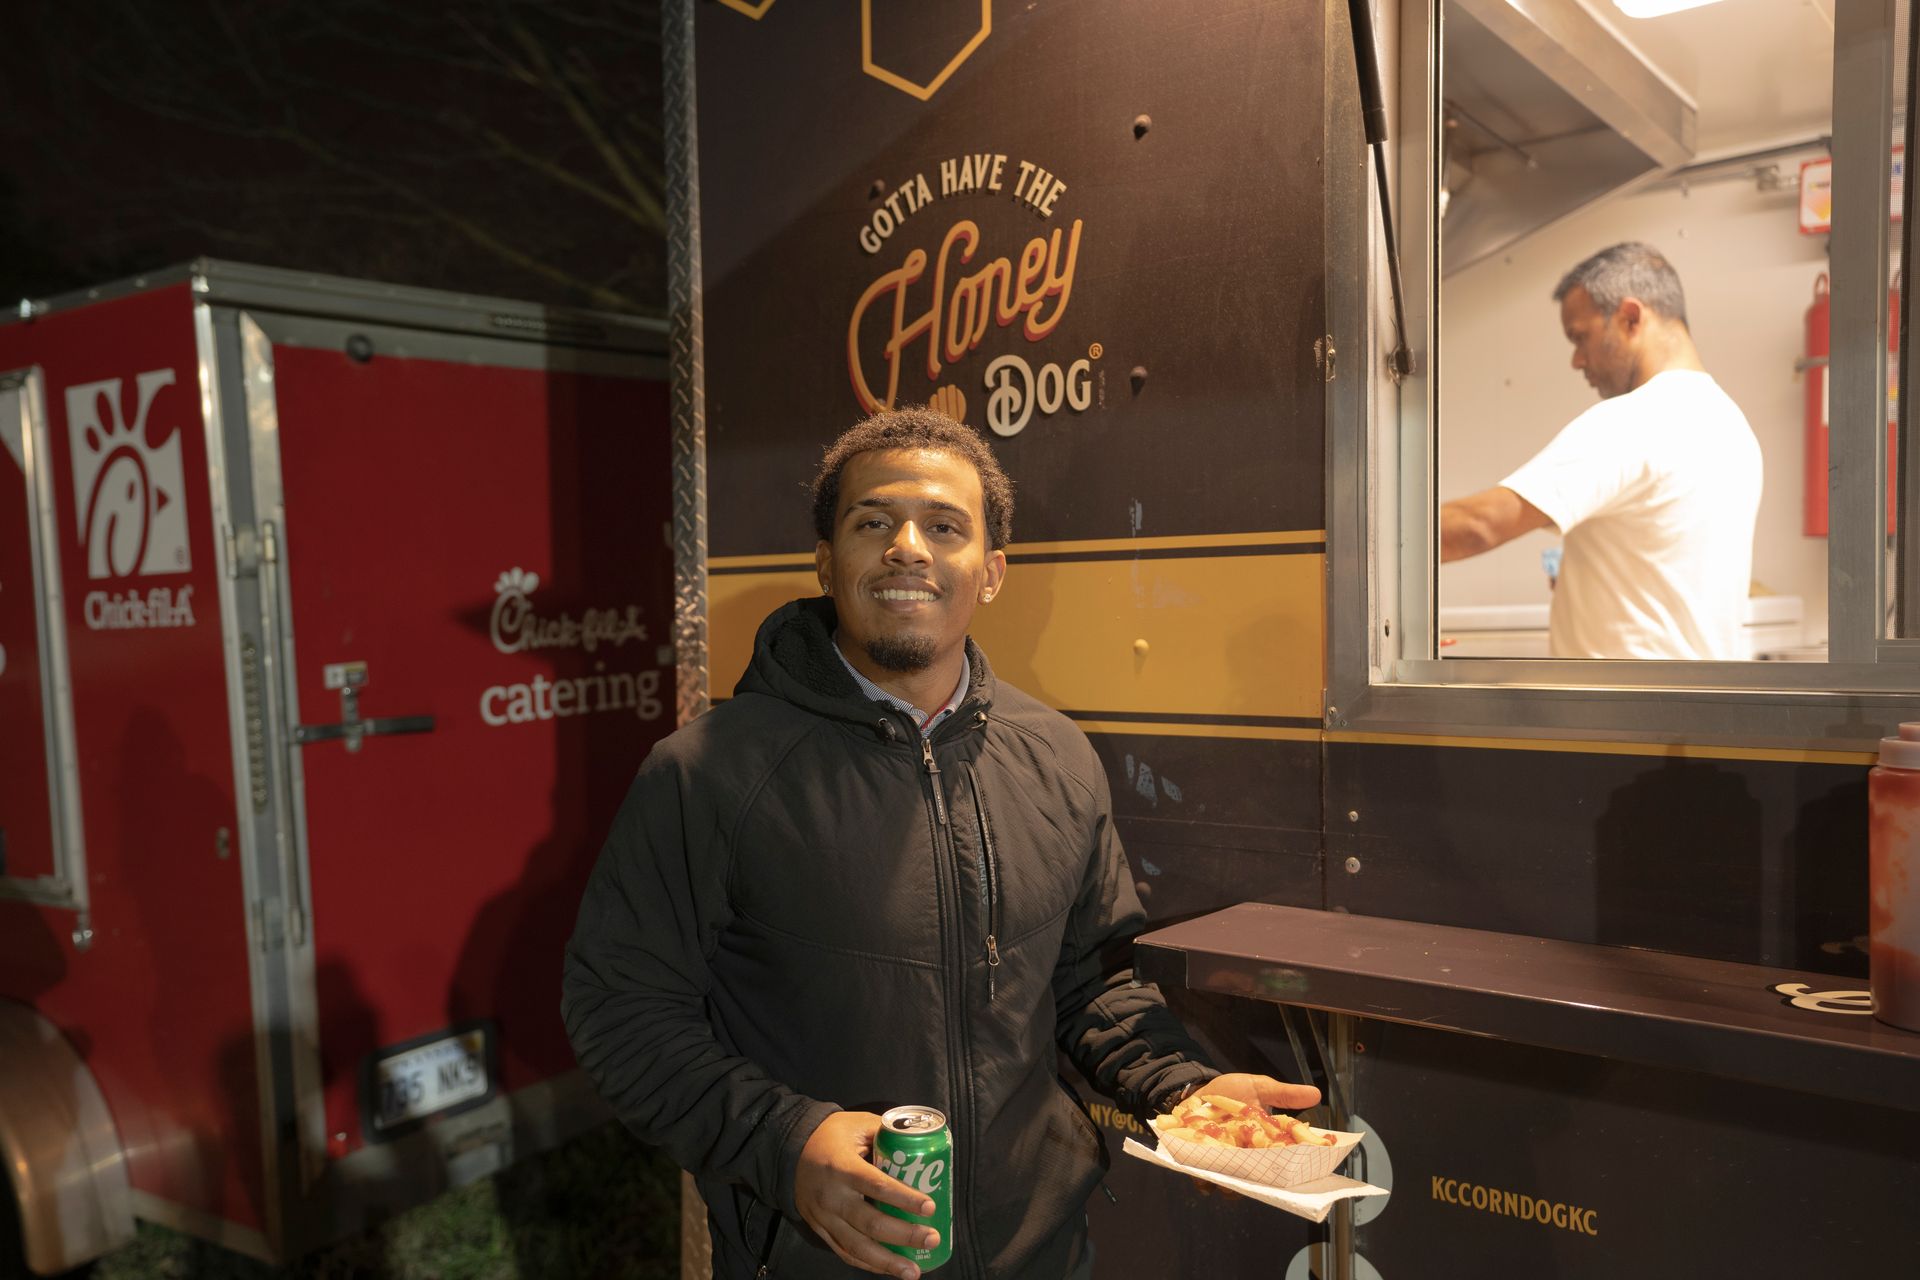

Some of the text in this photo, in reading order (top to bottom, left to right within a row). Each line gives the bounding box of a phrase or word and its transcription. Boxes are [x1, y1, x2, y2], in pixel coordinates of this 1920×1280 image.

[859, 153, 1068, 254] GOTTA HAVE THE
[847, 218, 1083, 418] Honey
[479, 660, 664, 727] catering
[1431, 1175, 1599, 1237] KCCORNDOGKC
